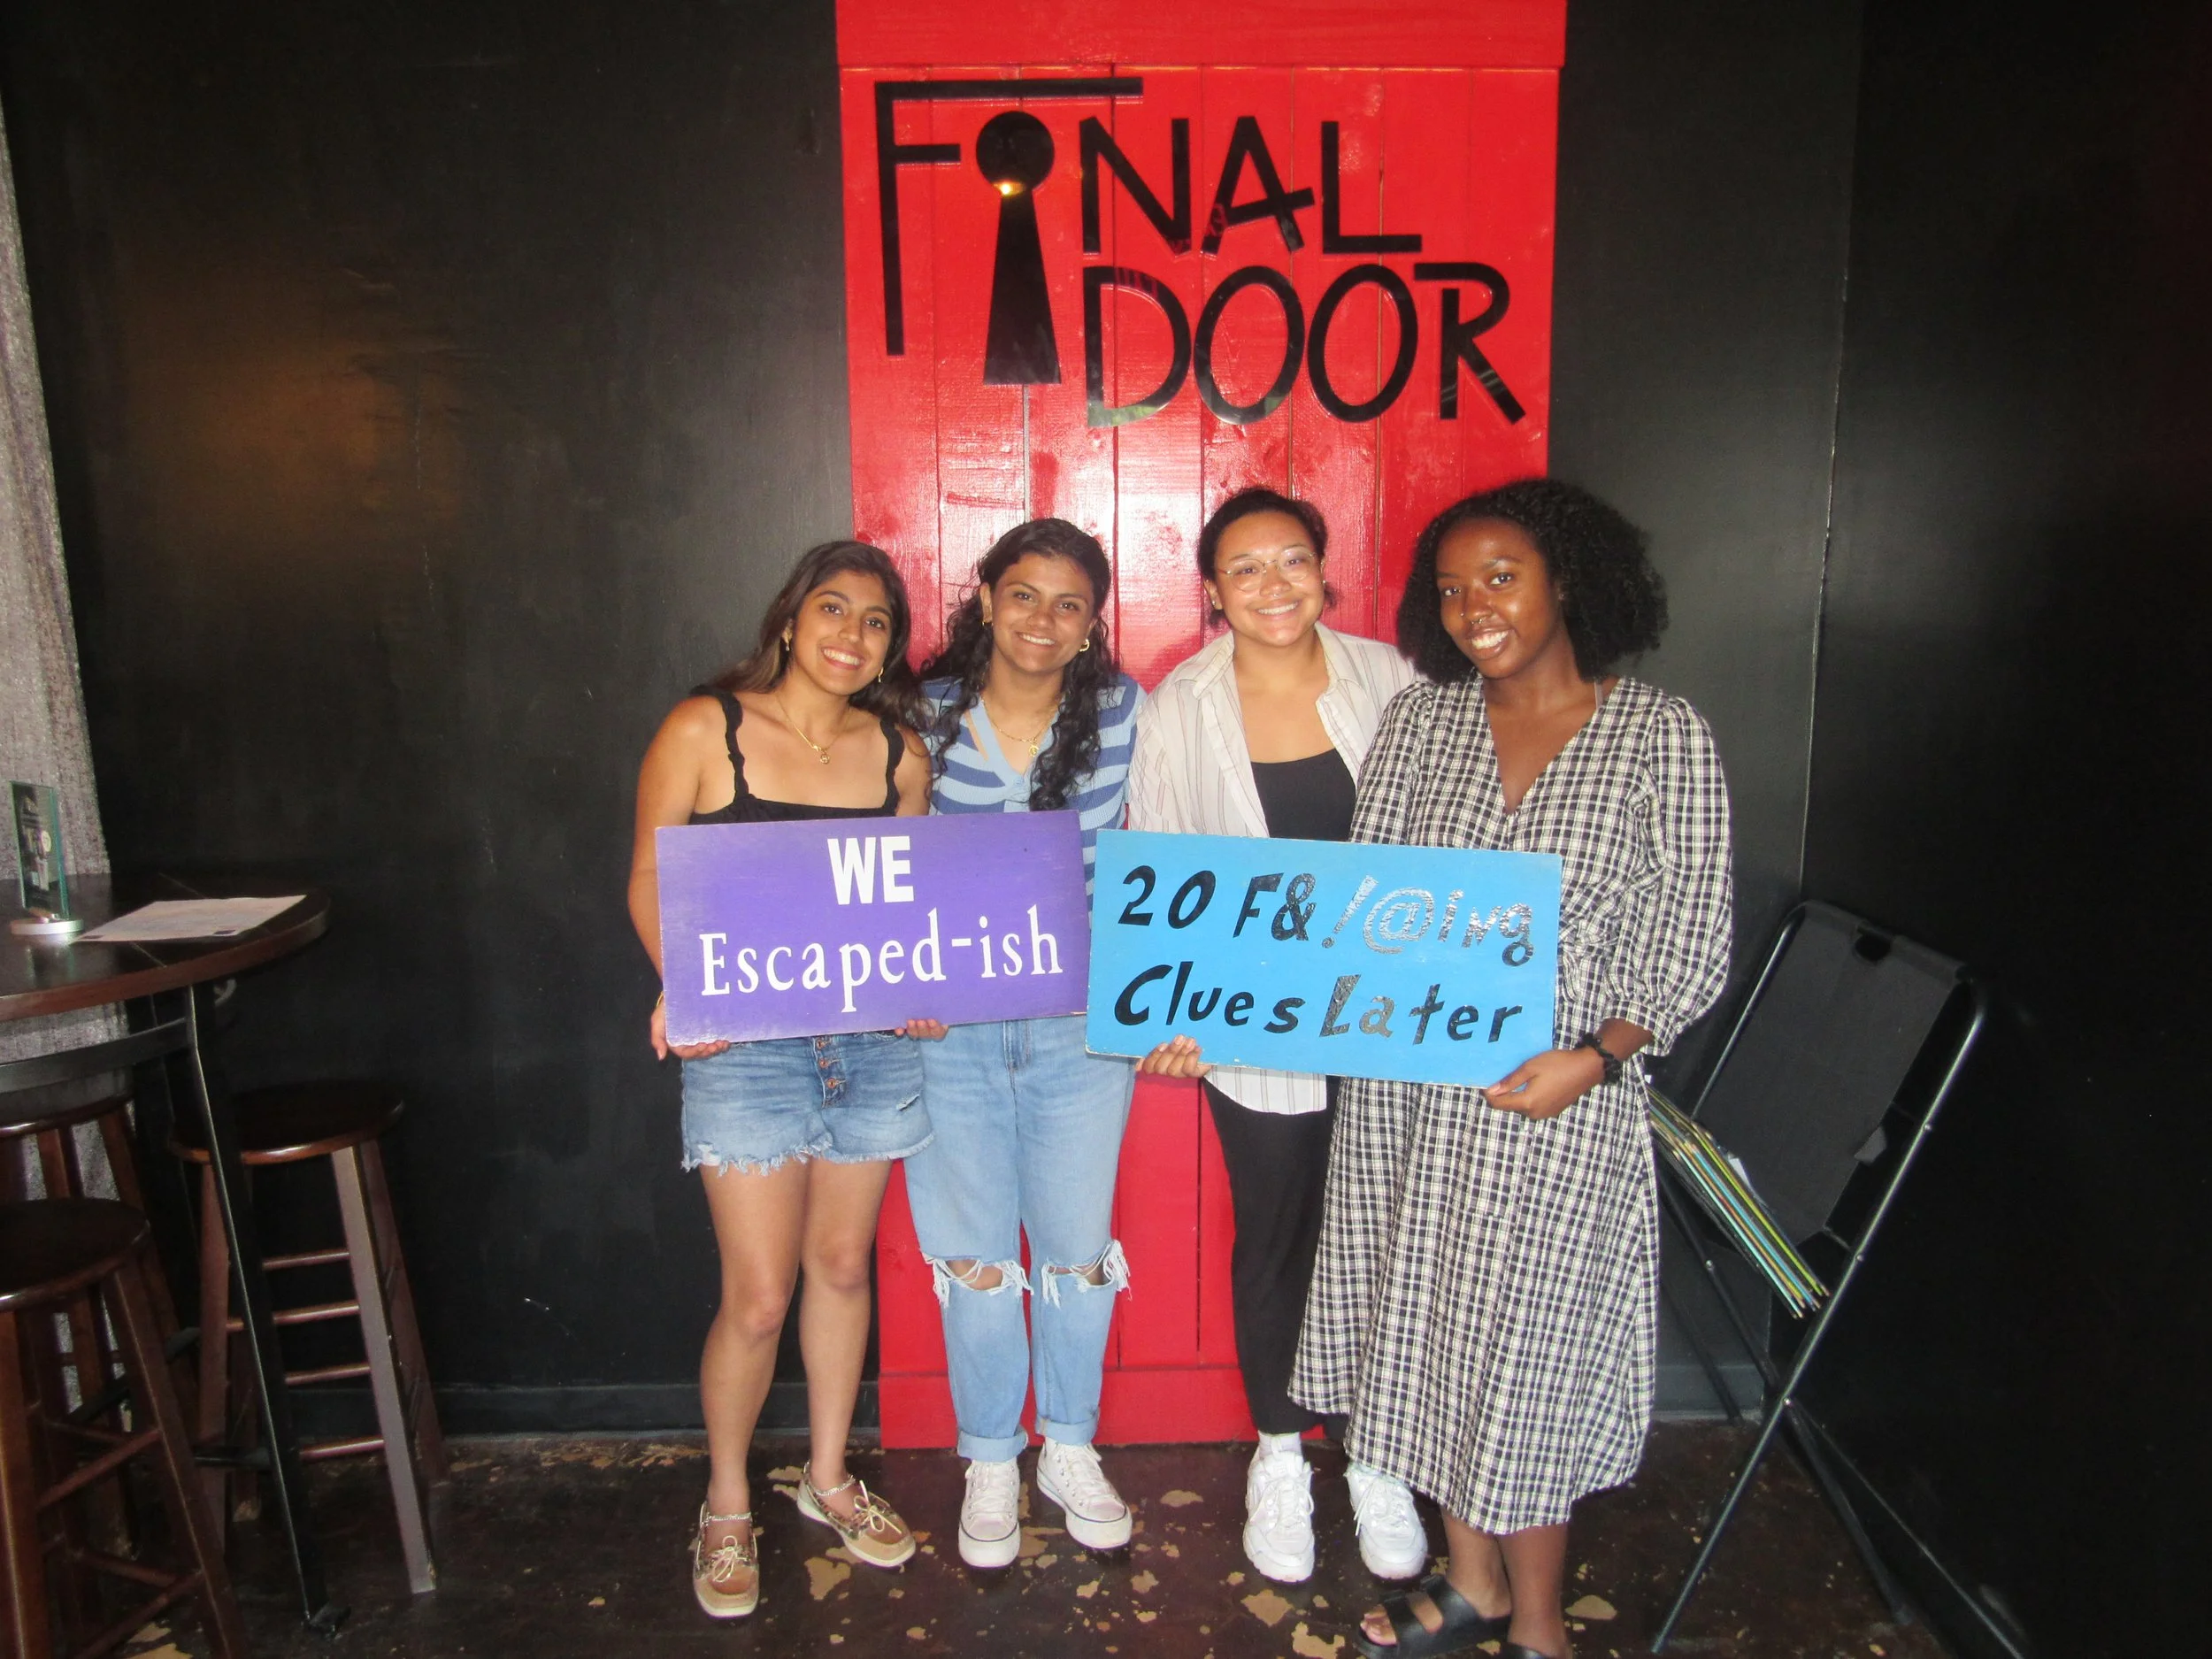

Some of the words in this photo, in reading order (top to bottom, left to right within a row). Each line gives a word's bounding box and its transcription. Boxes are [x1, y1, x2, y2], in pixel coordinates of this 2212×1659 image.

[1084, 263, 1526, 426] DOOR
[827, 835, 914, 905] WE
[1118, 865, 1217, 929] 20
[699, 904, 1063, 1013] Escaped-ish
[1114, 961, 1306, 1033] Clues
[1319, 974, 1523, 1045] Later
